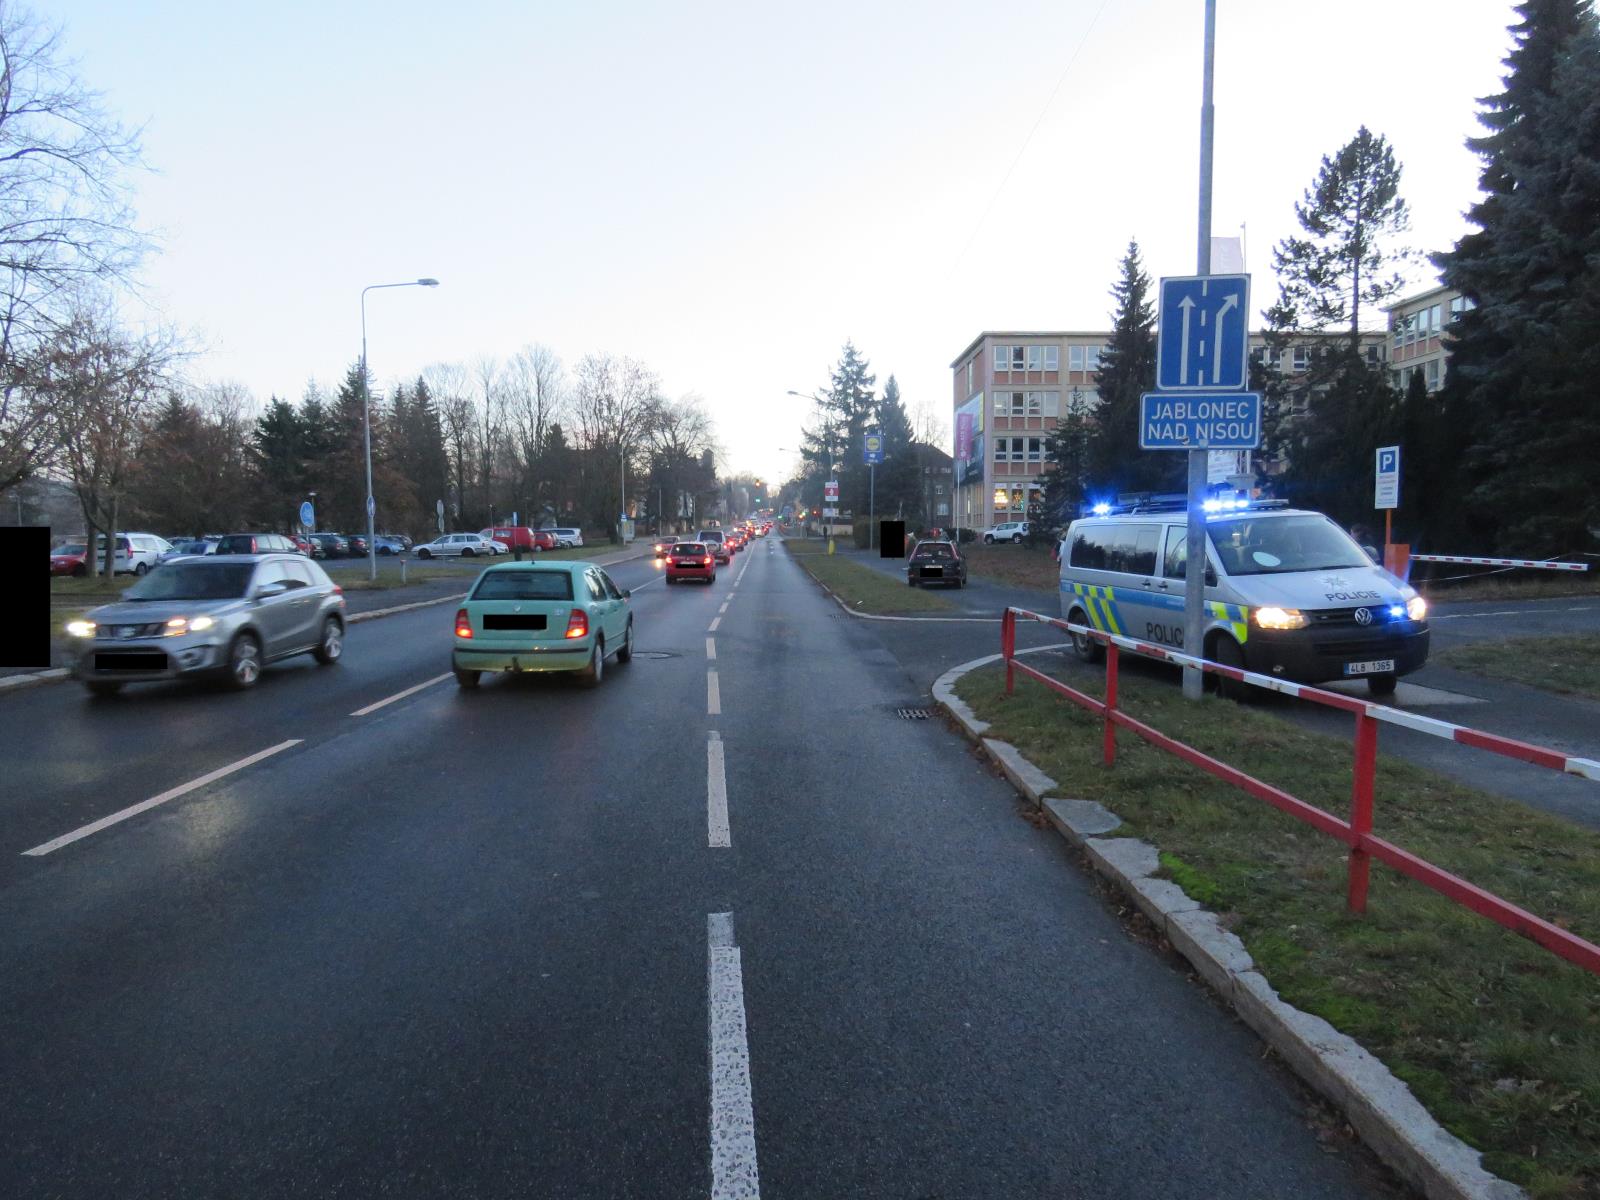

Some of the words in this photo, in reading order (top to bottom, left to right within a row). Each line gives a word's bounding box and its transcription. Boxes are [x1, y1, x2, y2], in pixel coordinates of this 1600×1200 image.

[1151, 402, 1249, 420] JABLONEC
[1148, 423, 1187, 440] NAD
[1195, 422, 1253, 440] NISOU
[1382, 454, 1393, 471] P
[1325, 591, 1381, 601] POLICIE
[1146, 622, 1185, 646] POLIC
